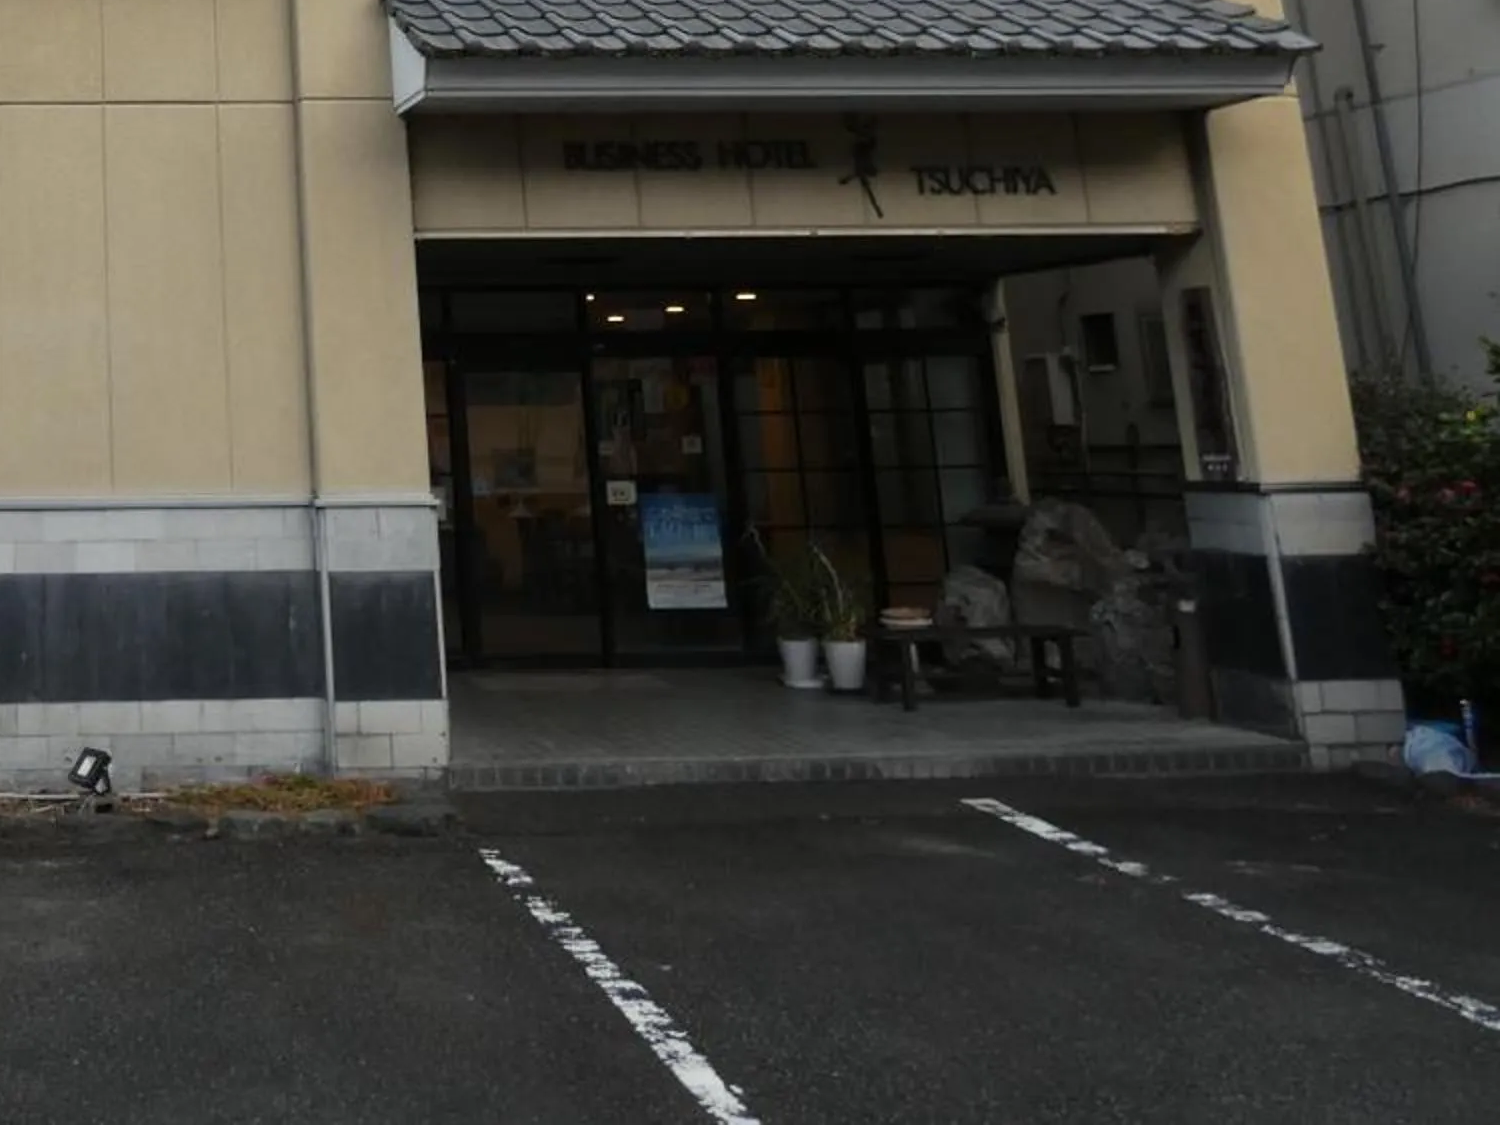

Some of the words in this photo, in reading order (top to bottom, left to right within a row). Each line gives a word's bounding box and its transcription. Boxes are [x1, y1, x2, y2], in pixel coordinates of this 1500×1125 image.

[562, 139, 703, 170] BUSINESS
[716, 139, 818, 169] HOTEL
[909, 165, 1057, 195] TSUCHIYA
